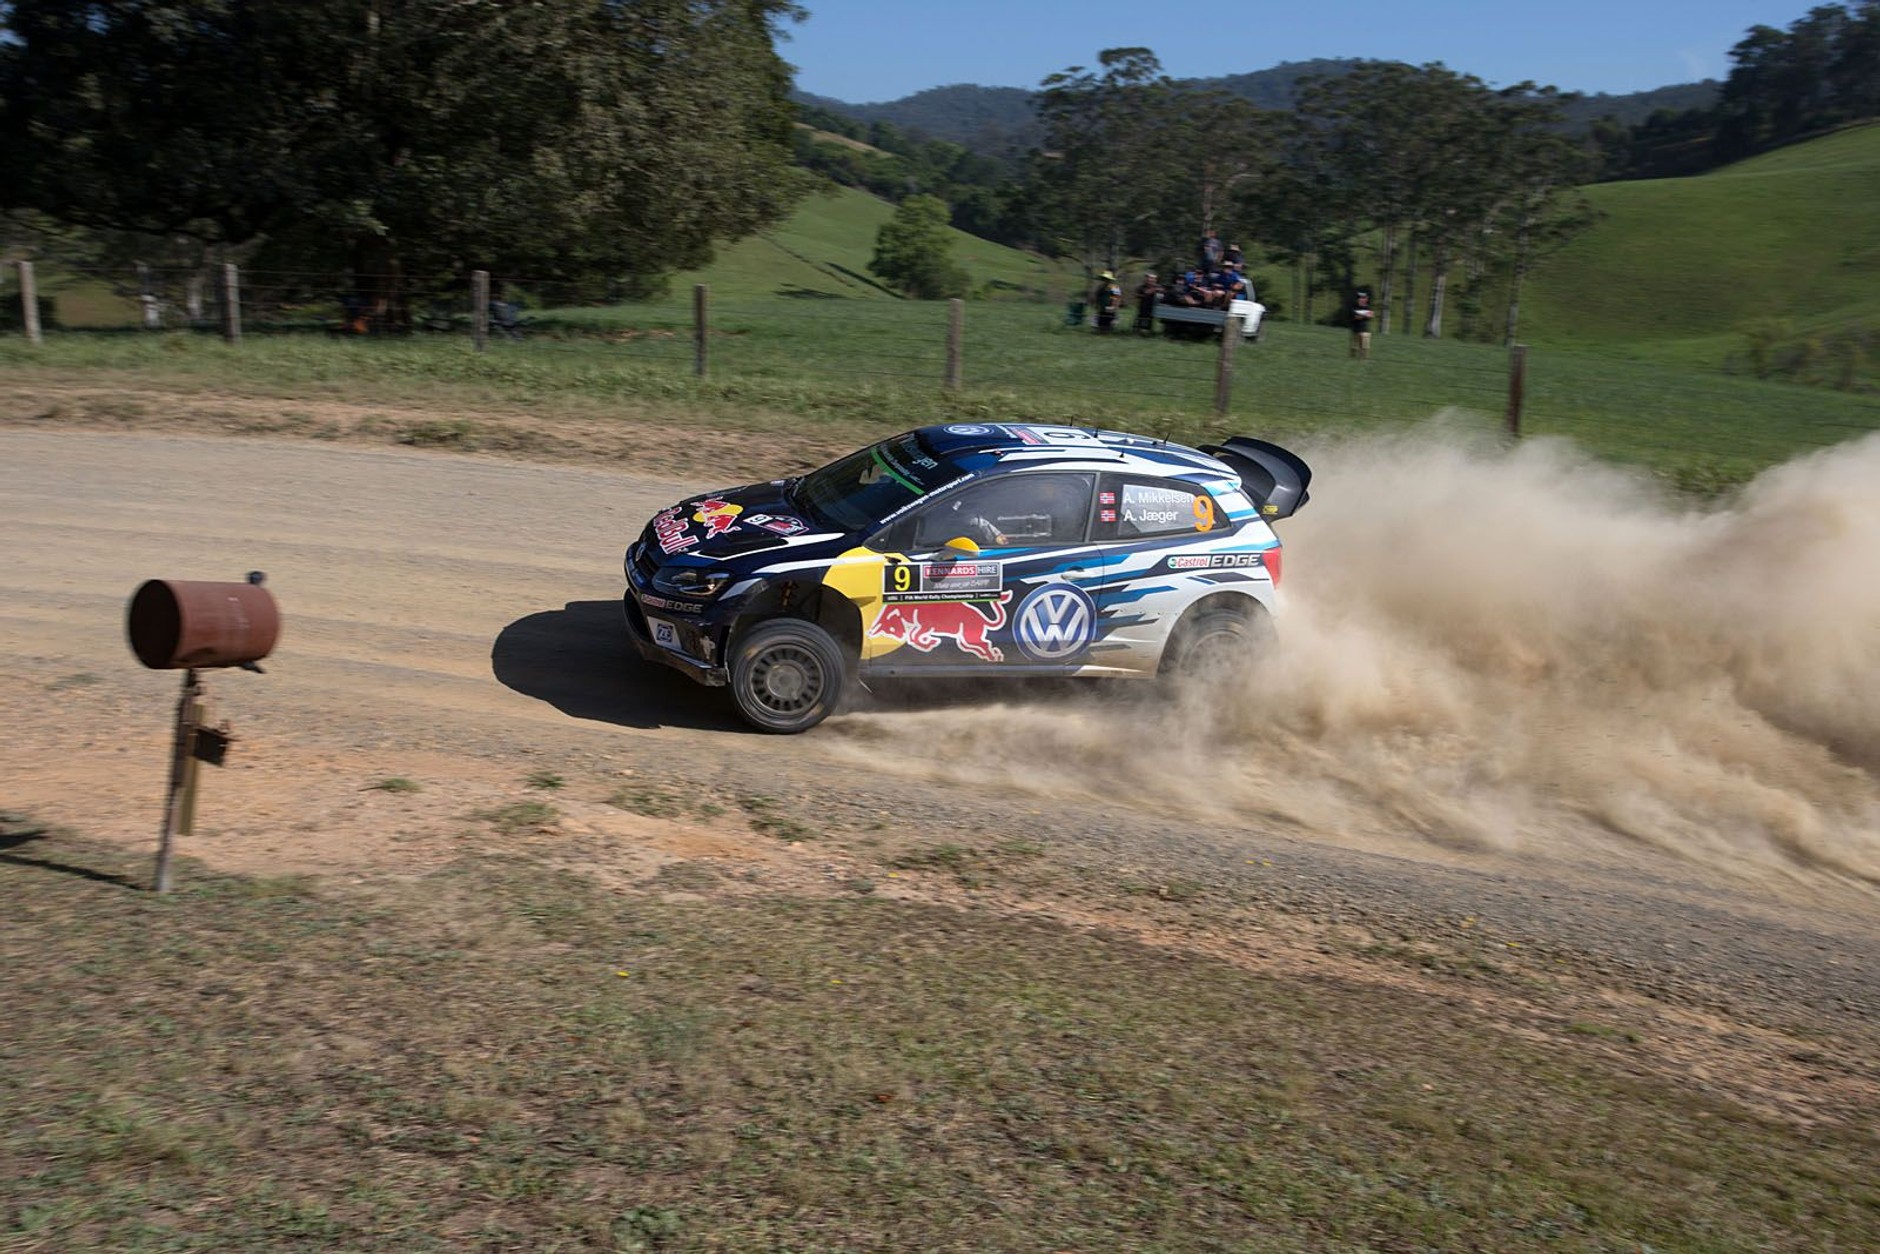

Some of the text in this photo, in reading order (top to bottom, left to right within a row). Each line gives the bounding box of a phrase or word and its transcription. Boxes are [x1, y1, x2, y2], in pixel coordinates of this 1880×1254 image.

[1123, 491, 1194, 504] A. Mikkelsen
[1123, 509, 1179, 524] A. Jæger
[1193, 494, 1214, 533] 9
[1176, 554, 1259, 568] Castrol EDGE
[926, 565, 997, 575] KENNARDS HIRE
[893, 566, 911, 592] 9
[666, 600, 703, 613] EDGE
